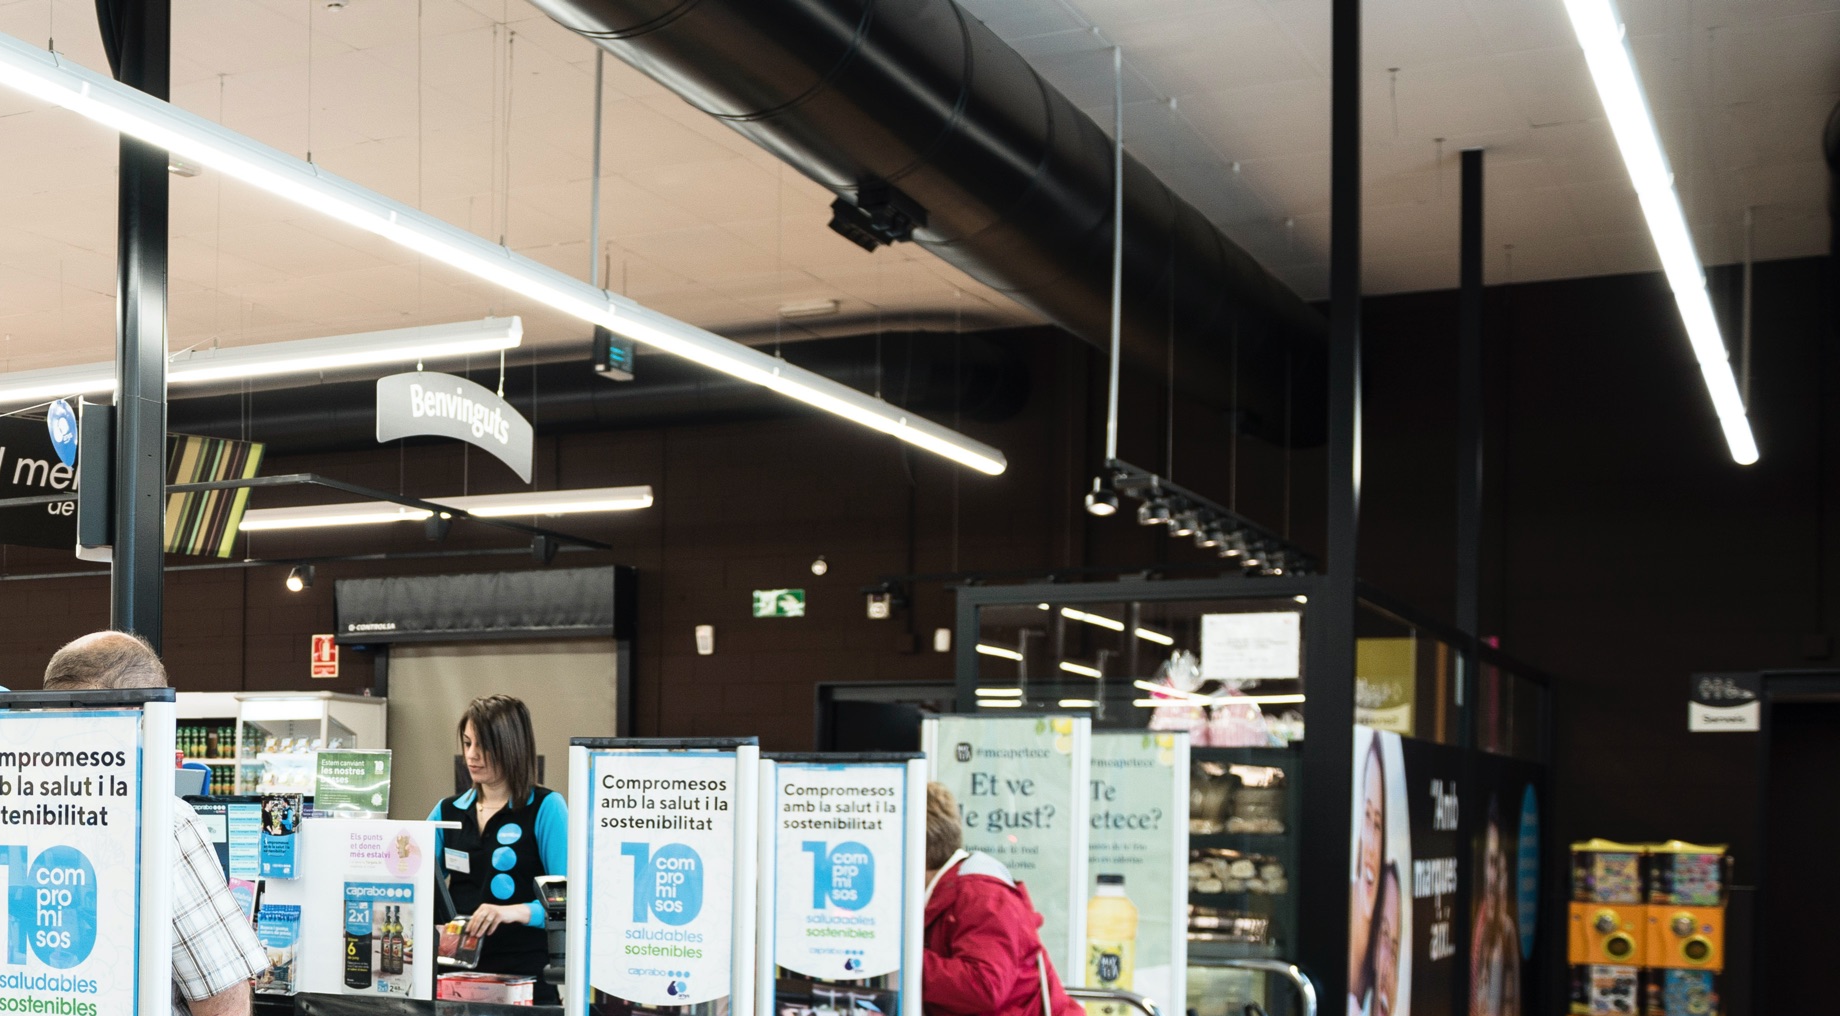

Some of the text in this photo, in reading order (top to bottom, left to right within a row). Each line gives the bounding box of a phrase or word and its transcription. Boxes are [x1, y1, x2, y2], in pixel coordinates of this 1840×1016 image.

[409, 383, 511, 445] Benvinguts
[321, 766, 365, 775] les nostres
[17, 775, 35, 796] la
[40, 775, 93, 797] salut
[98, 774, 104, 797] i
[109, 776, 128, 797] la
[602, 774, 727, 794] Compromesos
[784, 783, 895, 798] Compromesos
[971, 772, 1035, 796] Et ve
[1090, 780, 1116, 801] Te
[601, 795, 729, 811] amb la salut i la
[783, 801, 896, 813] amb la salut la
[601, 815, 713, 831] sostenibilitat
[783, 818, 883, 831] sostenibilitat
[987, 804, 1056, 832] gust?
[363, 833, 383, 841] punts
[359, 842, 381, 850] donen
[366, 851, 391, 859] estalvi
[832, 853, 868, 865] com
[656, 857, 696, 871] com
[832, 864, 859, 878] pro
[36, 867, 86, 886] com
[621, 841, 704, 926] 10
[656, 870, 685, 886] pro
[802, 841, 875, 912] 10
[346, 886, 386, 897] caprabo
[656, 883, 677, 899] mi
[36, 888, 72, 911] pro
[655, 900, 683, 913] sos
[36, 905, 63, 927] mi
[348, 909, 370, 923] 2x1
[806, 914, 875, 925] saludables
[36, 930, 71, 949] sos
[625, 928, 704, 944] saludables
[806, 927, 875, 939] sostenibles
[347, 942, 357, 956] 6
[625, 943, 703, 959] sostenibles
[628, 967, 667, 977] caprabo
[0, 972, 98, 994] saludables
[0, 995, 97, 1016] sostenibles
